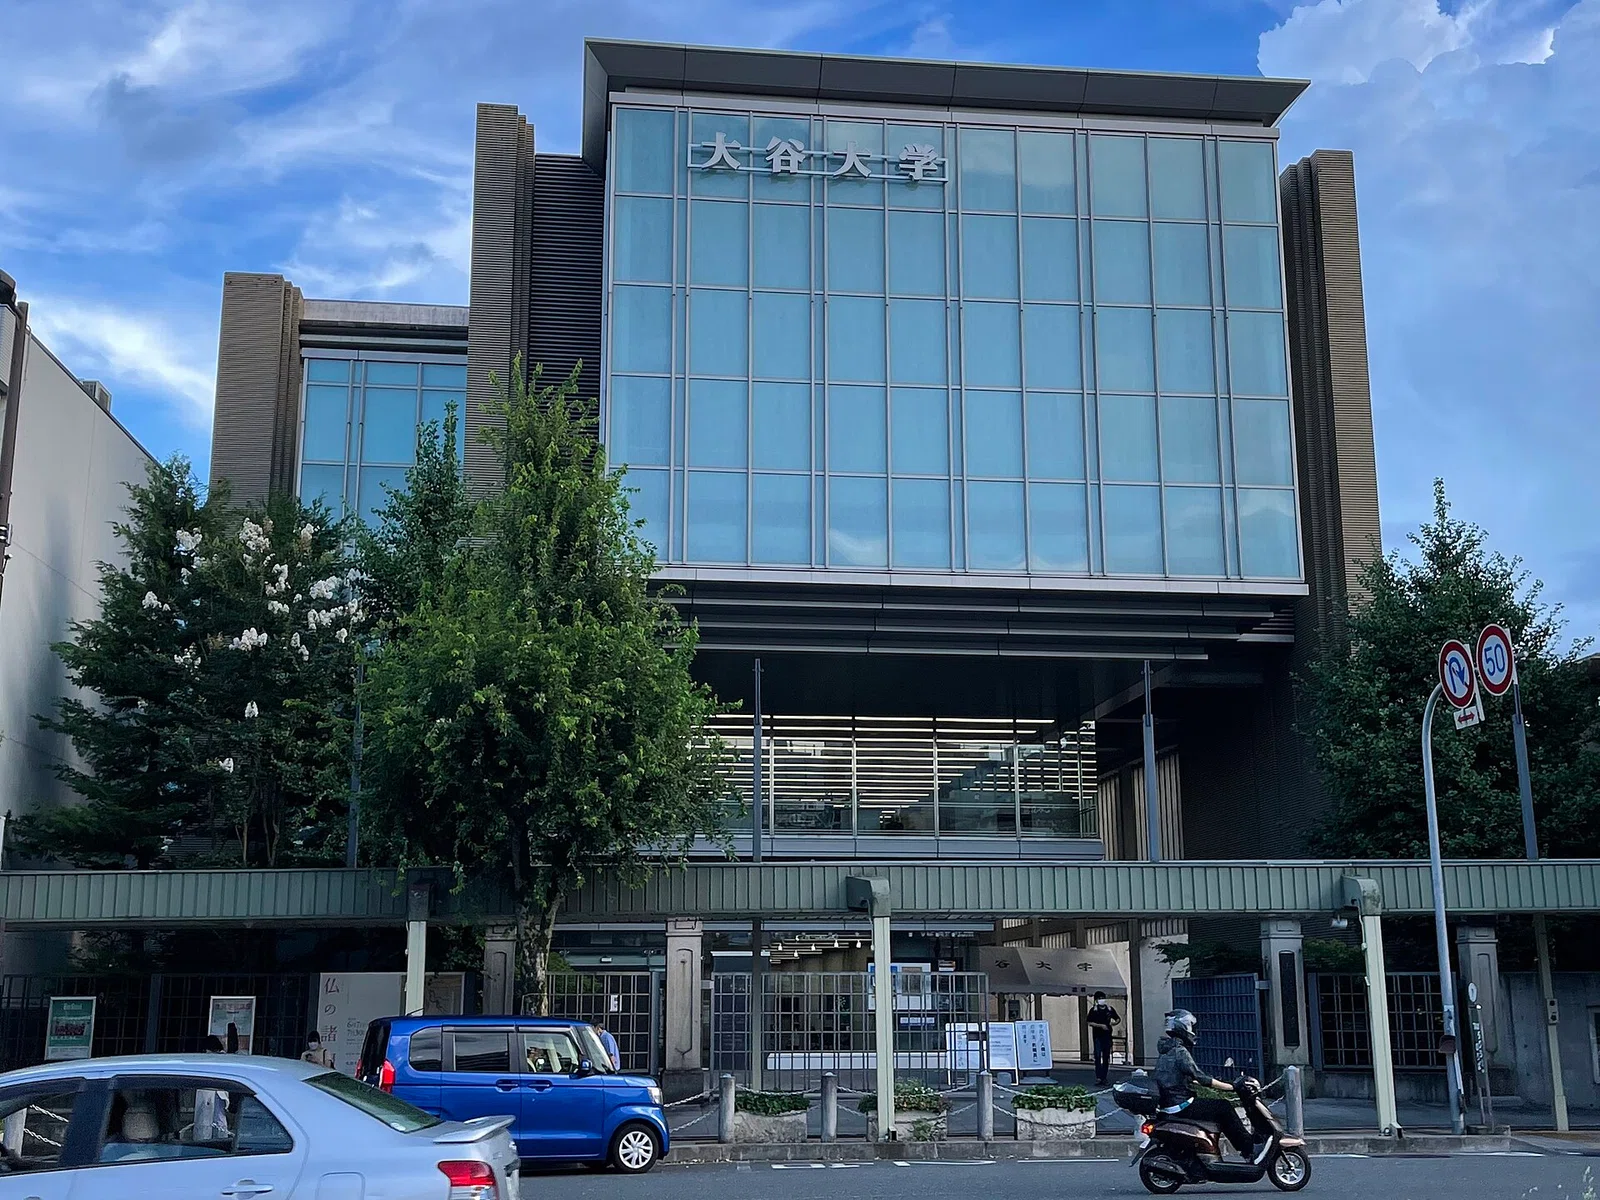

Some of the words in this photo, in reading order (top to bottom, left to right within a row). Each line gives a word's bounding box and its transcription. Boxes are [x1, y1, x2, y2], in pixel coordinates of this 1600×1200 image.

[701, 131, 939, 181] 大谷大学
[1484, 643, 1506, 677] 50
[321, 977, 340, 1064] 仏の諸
